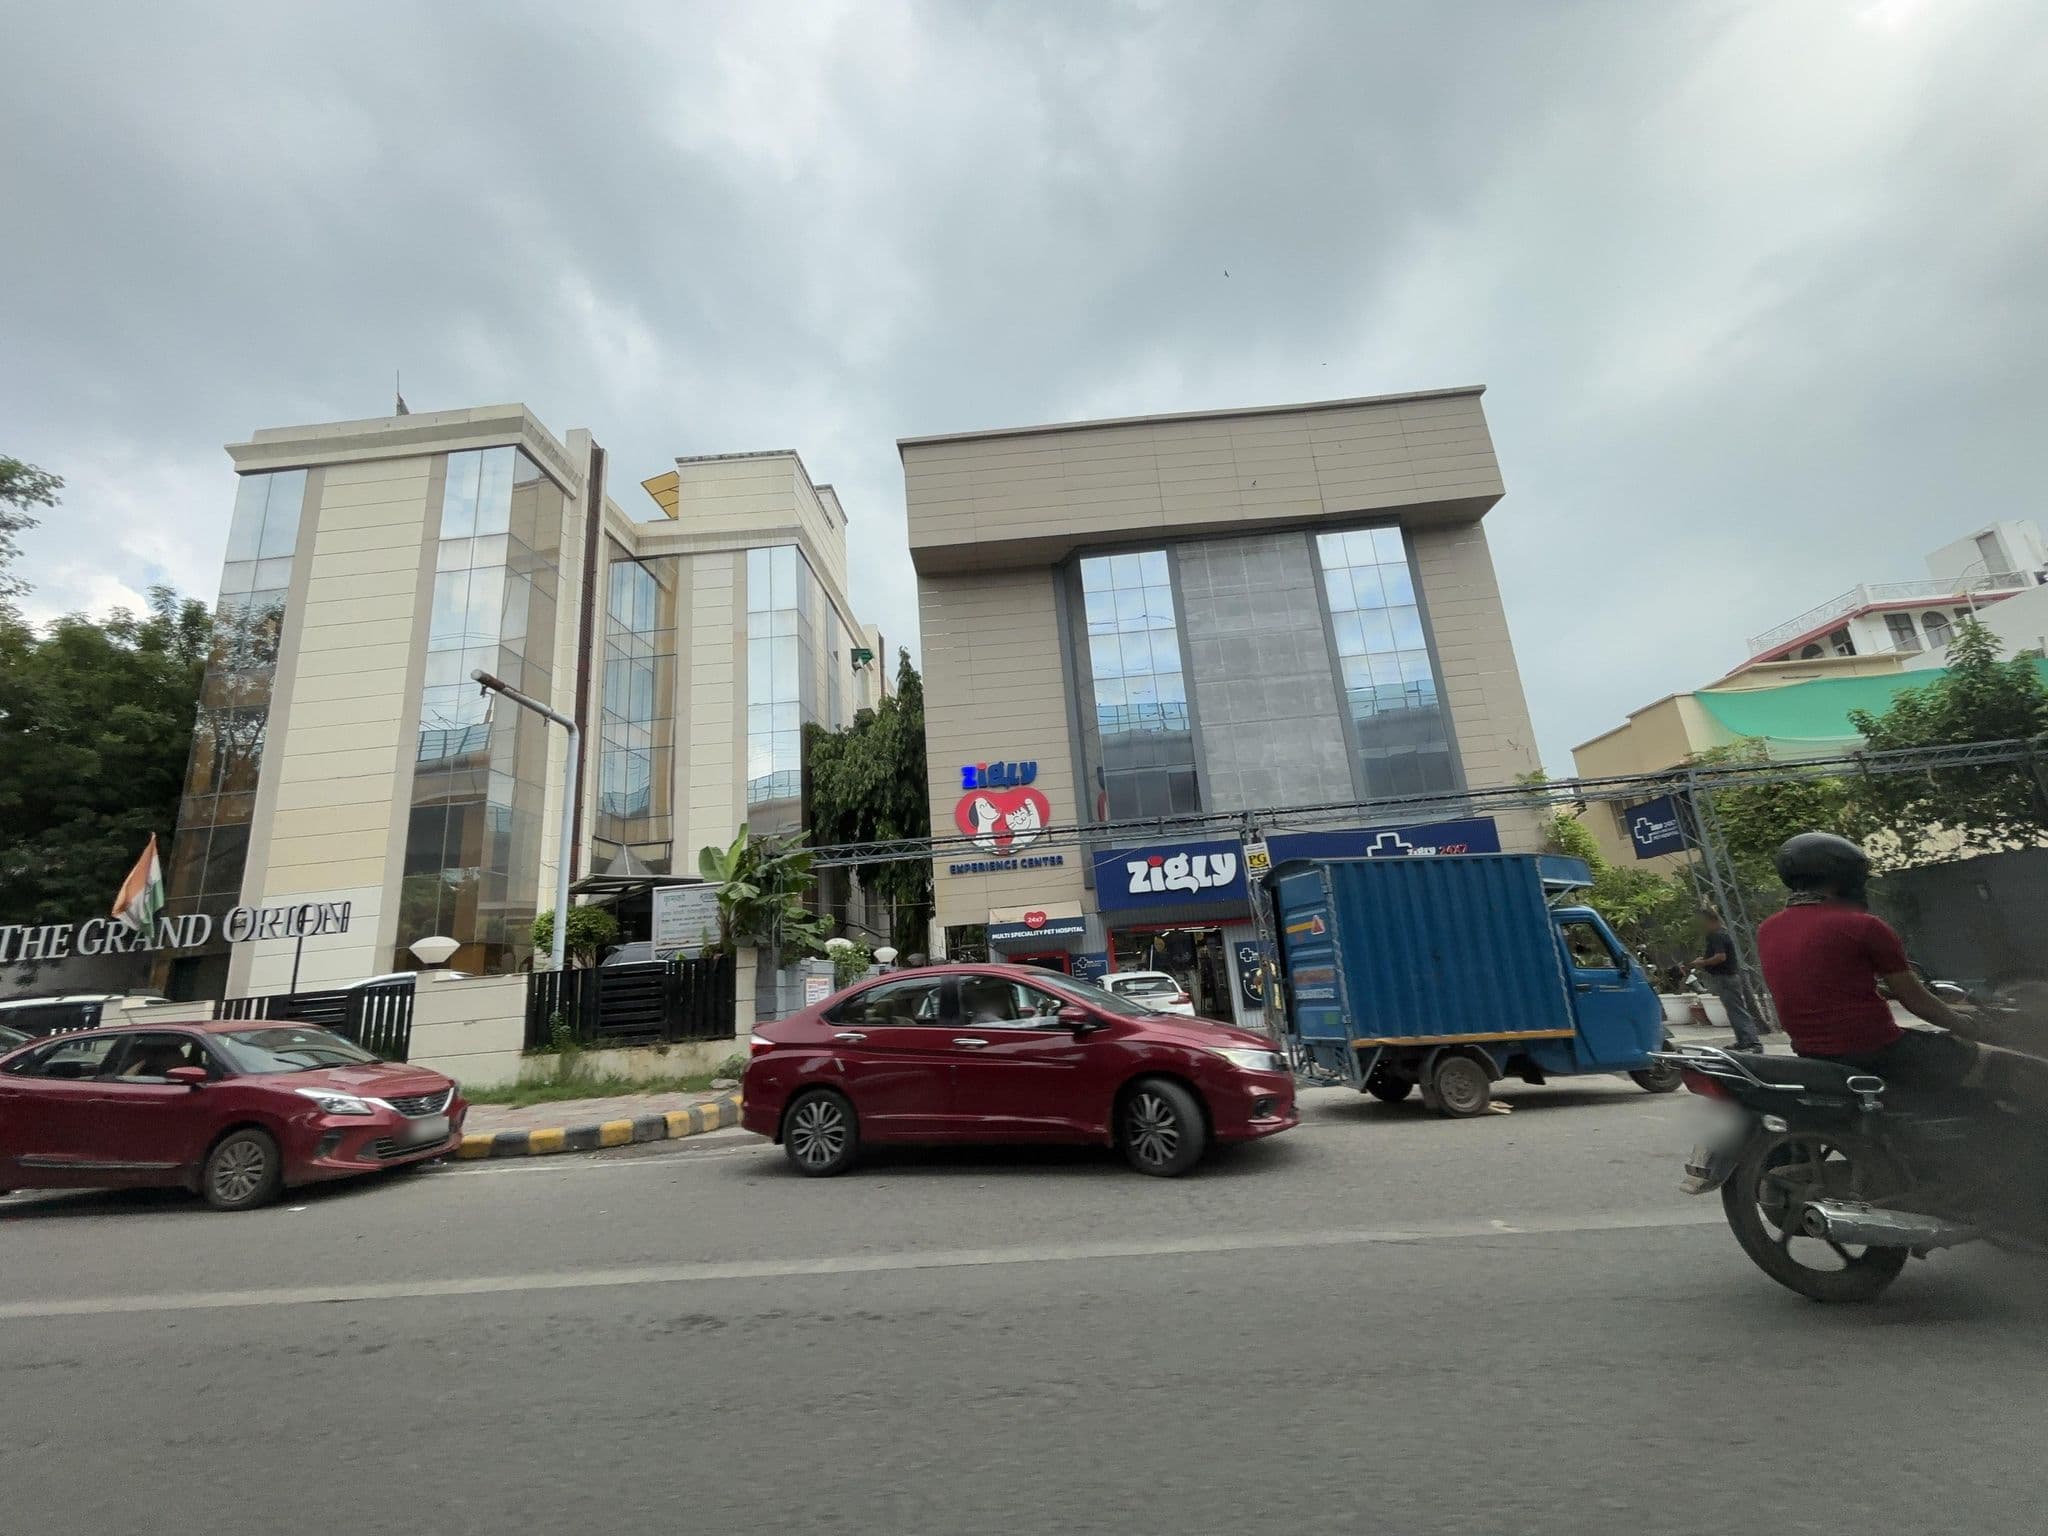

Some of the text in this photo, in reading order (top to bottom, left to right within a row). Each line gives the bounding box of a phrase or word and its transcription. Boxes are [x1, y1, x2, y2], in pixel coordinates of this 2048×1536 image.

[949, 855, 1064, 875] EXPERIENCE CENTER
[1248, 853, 1268, 865] PG
[0, 924, 73, 963] THE
[222, 901, 351, 943] ORION
[1010, 929, 1044, 939] SPECIALITY
[1043, 928, 1055, 936] PET
[1055, 926, 1085, 935] HOSPITAL
